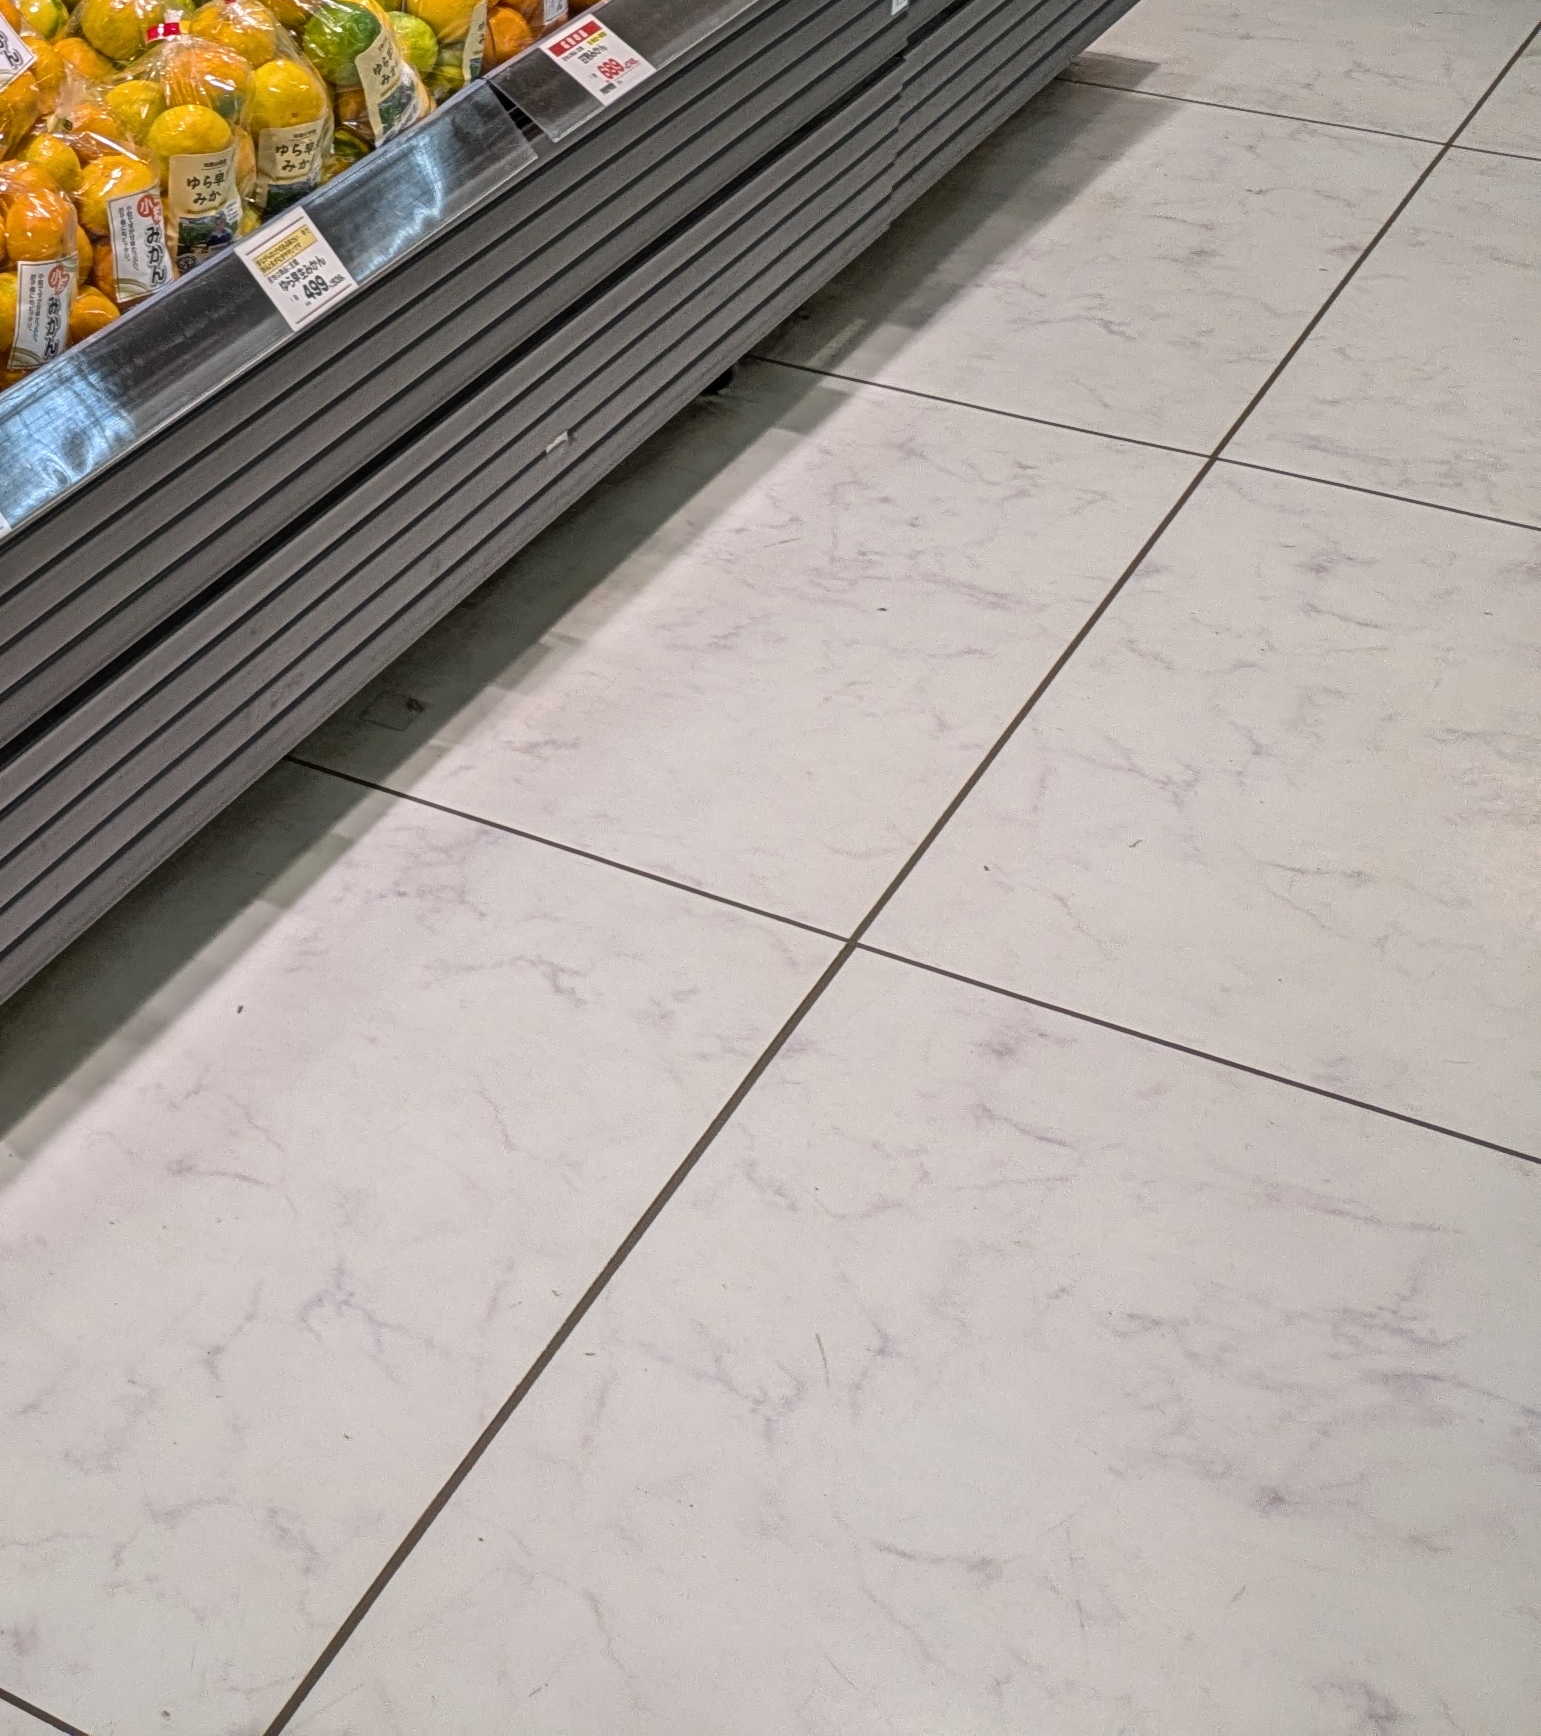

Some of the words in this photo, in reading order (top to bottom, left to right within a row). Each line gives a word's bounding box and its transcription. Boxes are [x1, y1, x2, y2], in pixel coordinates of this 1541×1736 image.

[597, 59, 626, 83] 689
[145, 225, 166, 287] みかん
[279, 255, 327, 291] ゆら早生みかん
[301, 273, 330, 301] 499
[46, 295, 64, 361] みかん
